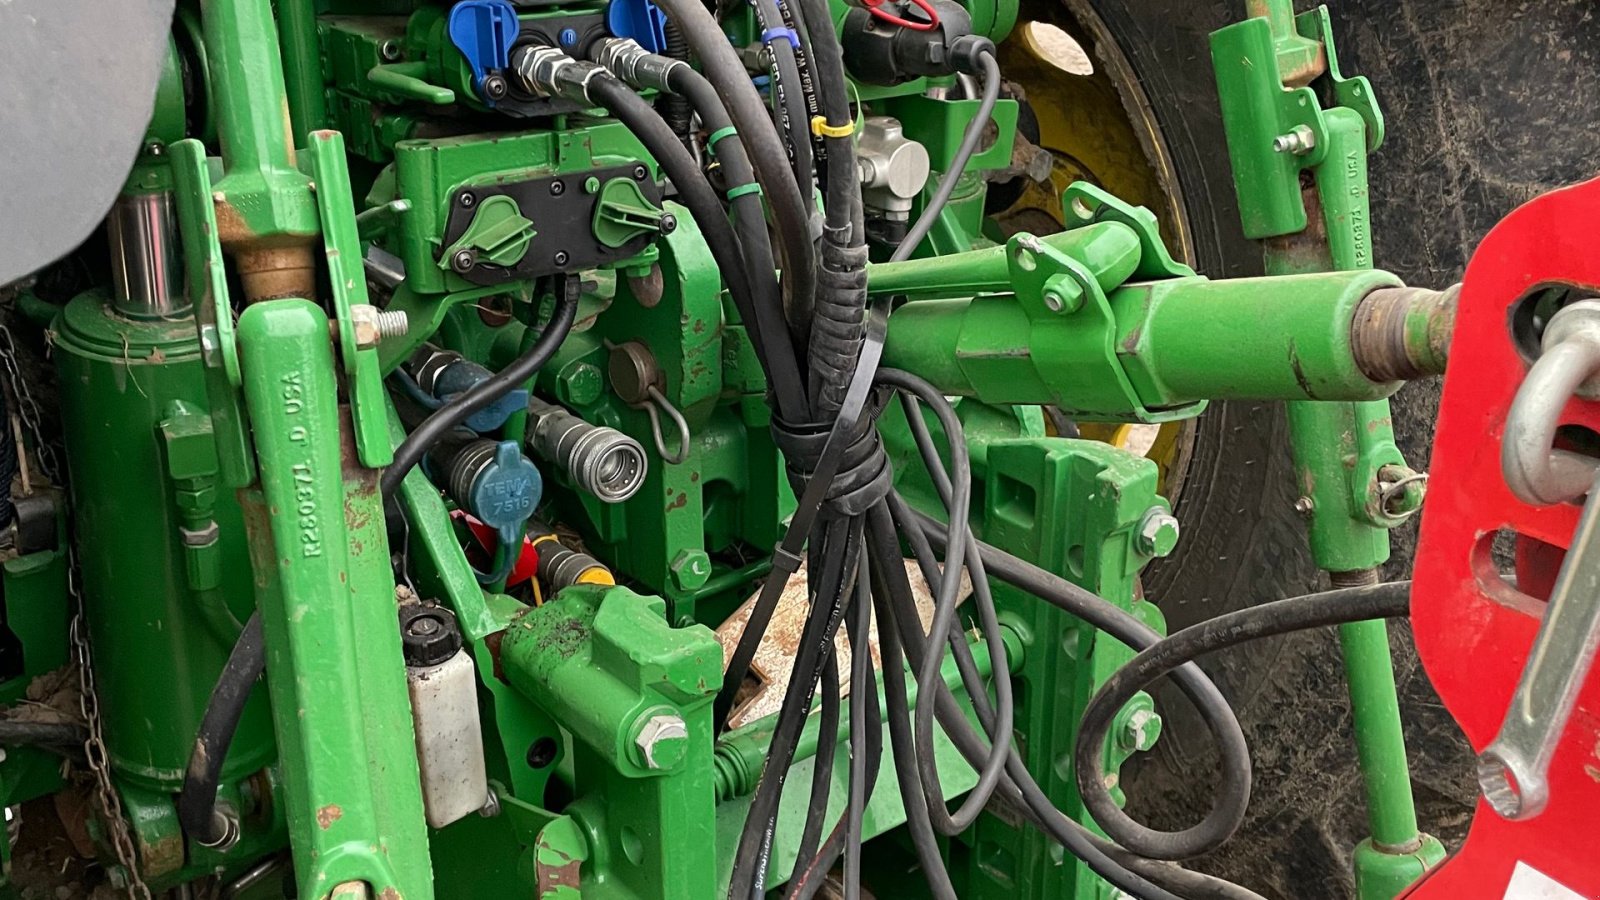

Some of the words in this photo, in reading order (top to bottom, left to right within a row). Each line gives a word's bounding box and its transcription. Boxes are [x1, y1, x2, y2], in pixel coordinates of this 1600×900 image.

[1347, 150, 1358, 179] USA
[281, 370, 304, 415] USA
[484, 478, 532, 497] TEMA
[493, 496, 530, 515] 7516
